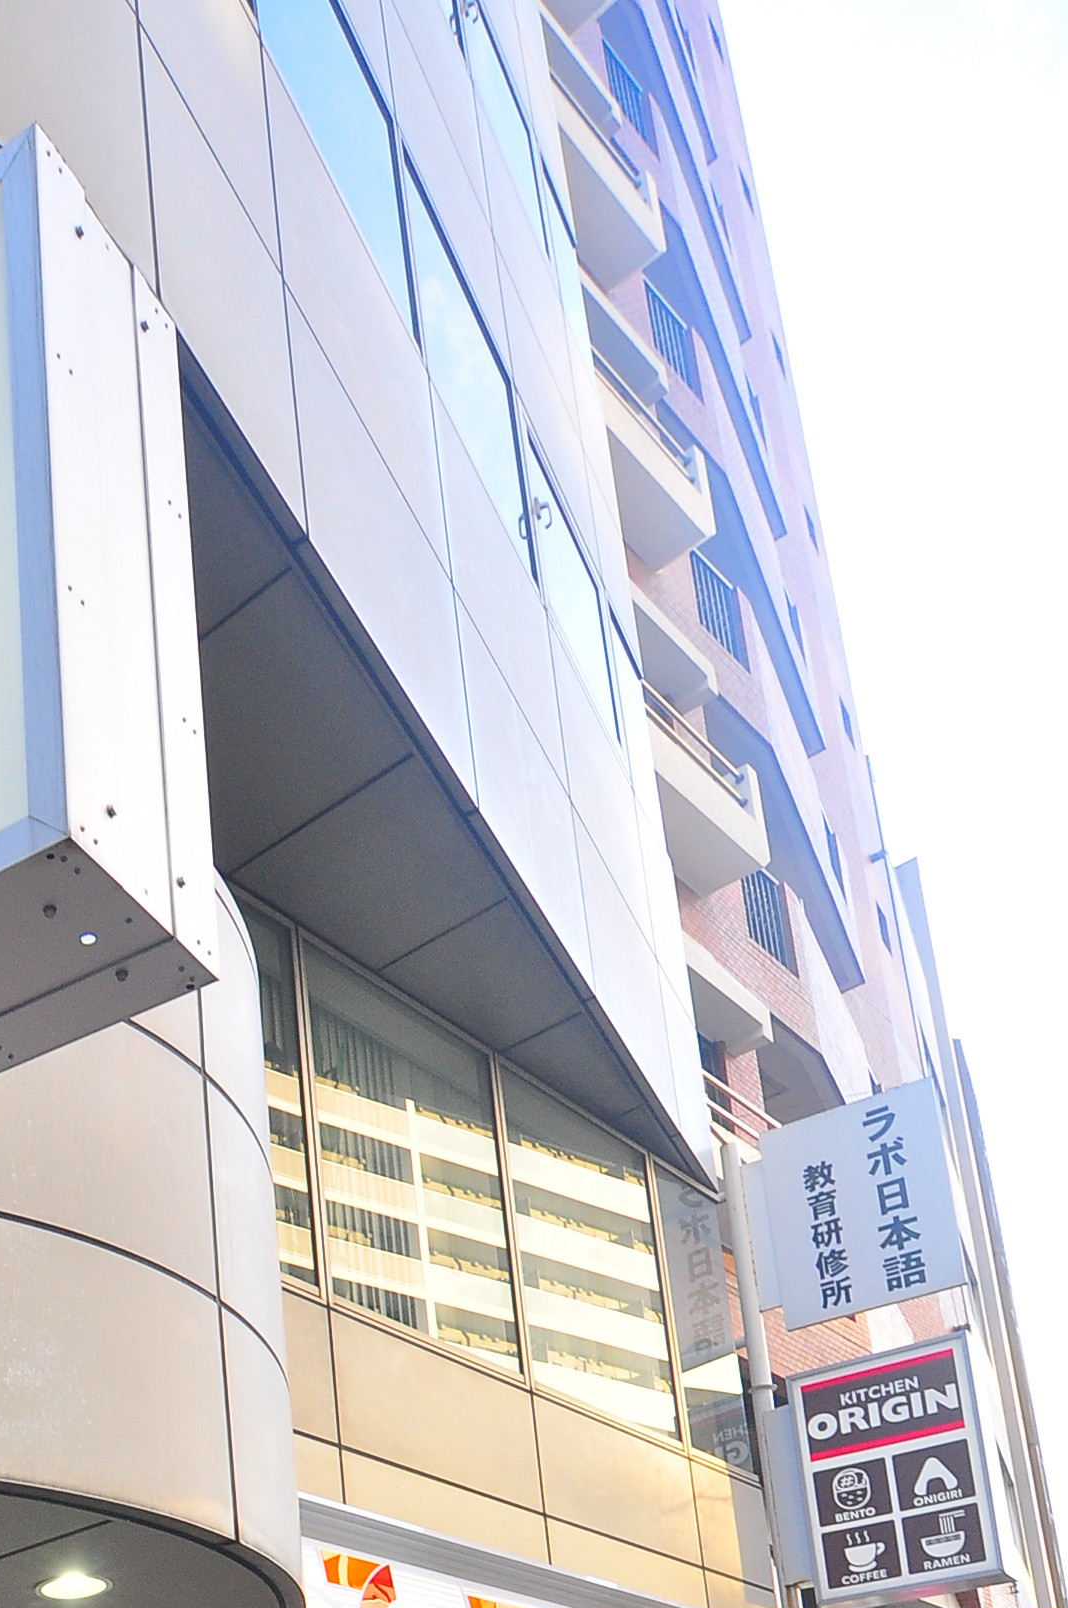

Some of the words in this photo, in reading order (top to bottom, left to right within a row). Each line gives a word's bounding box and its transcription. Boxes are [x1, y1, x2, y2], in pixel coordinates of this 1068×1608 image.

[861, 1105, 928, 1292] ラボ日本語
[802, 1160, 853, 1309] 教育研修所
[840, 1376, 920, 1407] KITCHEN
[807, 1383, 960, 1441] ORIGIN
[913, 1488, 963, 1507] ONIGIRI
[835, 1507, 876, 1523] BENTO
[923, 1554, 971, 1571] RAMEN
[841, 1569, 888, 1585] COFFEE
